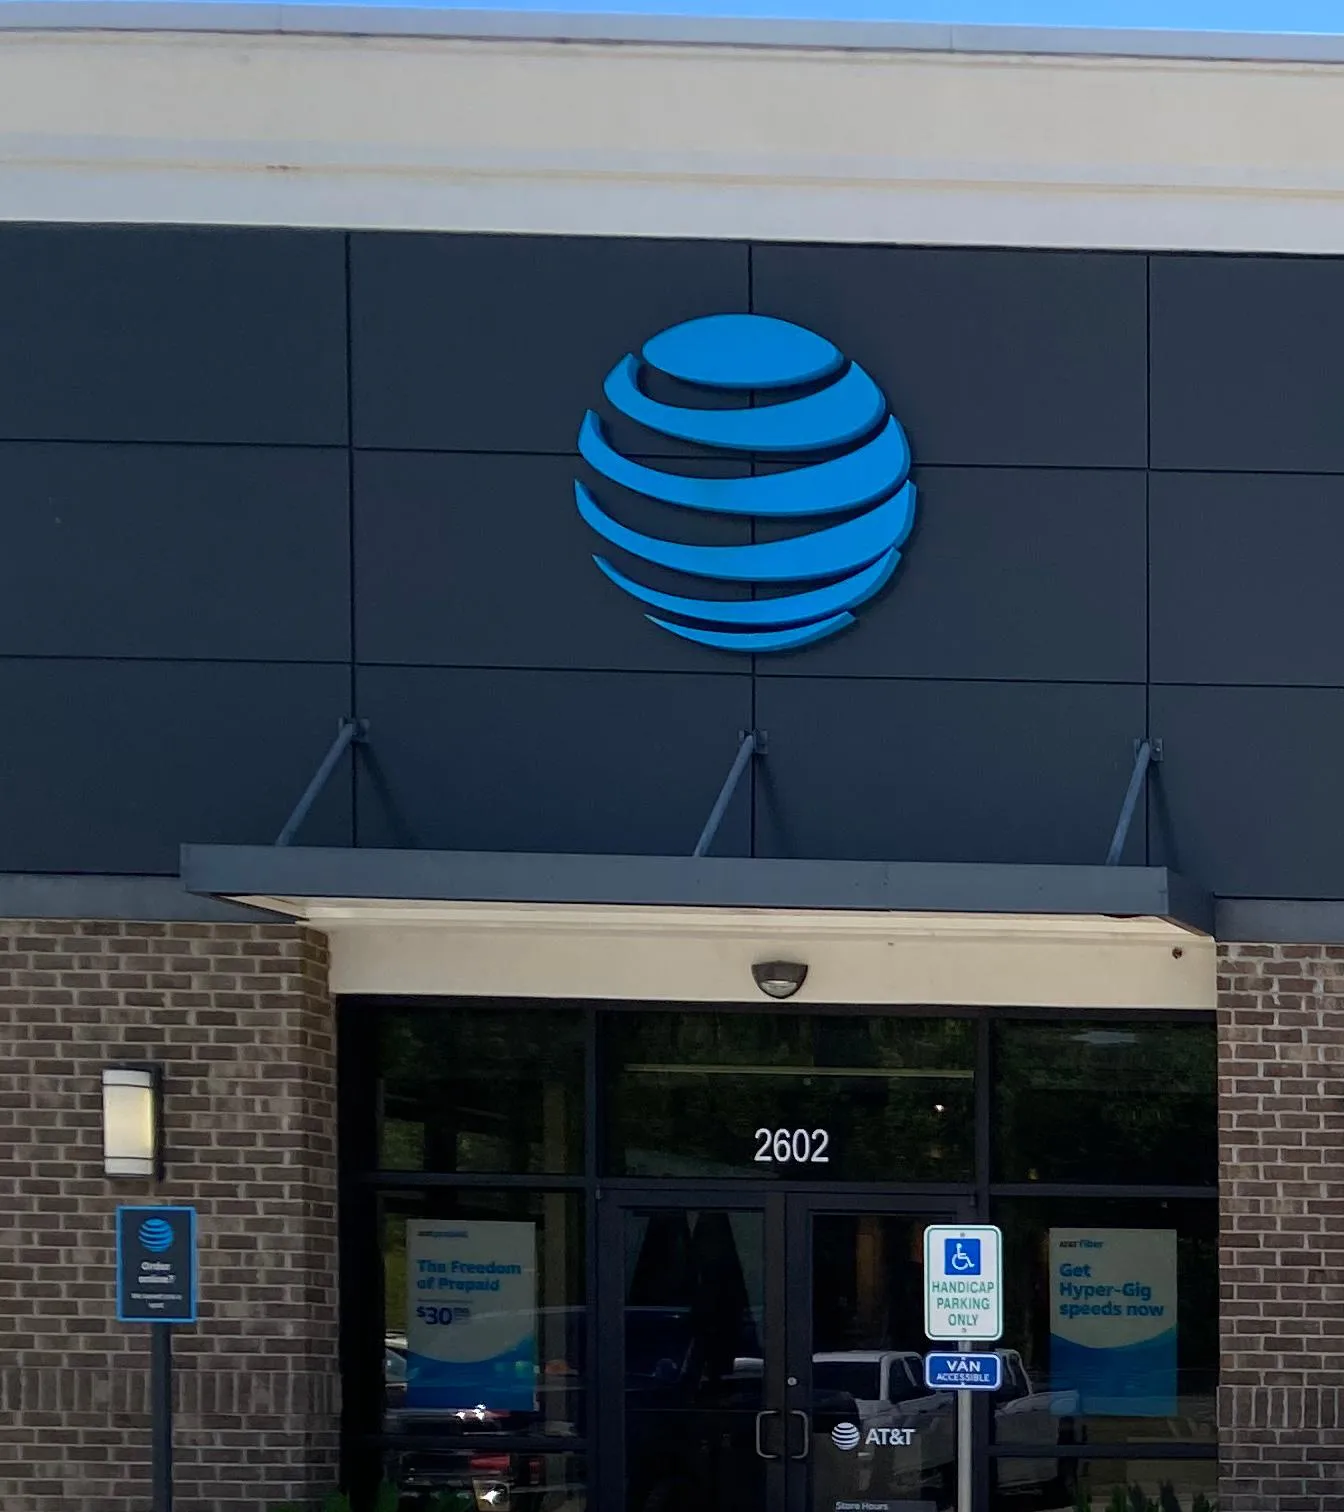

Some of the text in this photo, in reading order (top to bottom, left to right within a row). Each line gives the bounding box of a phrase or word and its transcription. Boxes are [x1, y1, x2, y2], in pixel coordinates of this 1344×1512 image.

[754, 1128, 829, 1162] 2602
[416, 1259, 522, 1275] The Freedom
[1059, 1263, 1092, 1278] Get
[417, 1276, 500, 1293] of Prepaid
[931, 1281, 994, 1294] HANDICAP
[1060, 1281, 1152, 1301] Hyper-Gig
[936, 1297, 990, 1310] PARKING
[1059, 1301, 1164, 1319] speeds now
[416, 1306, 453, 1325] $30
[948, 1314, 979, 1326] ONLY
[946, 1360, 981, 1372] VAN
[936, 1373, 990, 1382] ACCESSIBLE
[865, 1428, 916, 1446] AT&T
[835, 1501, 889, 1511] Store Hours
